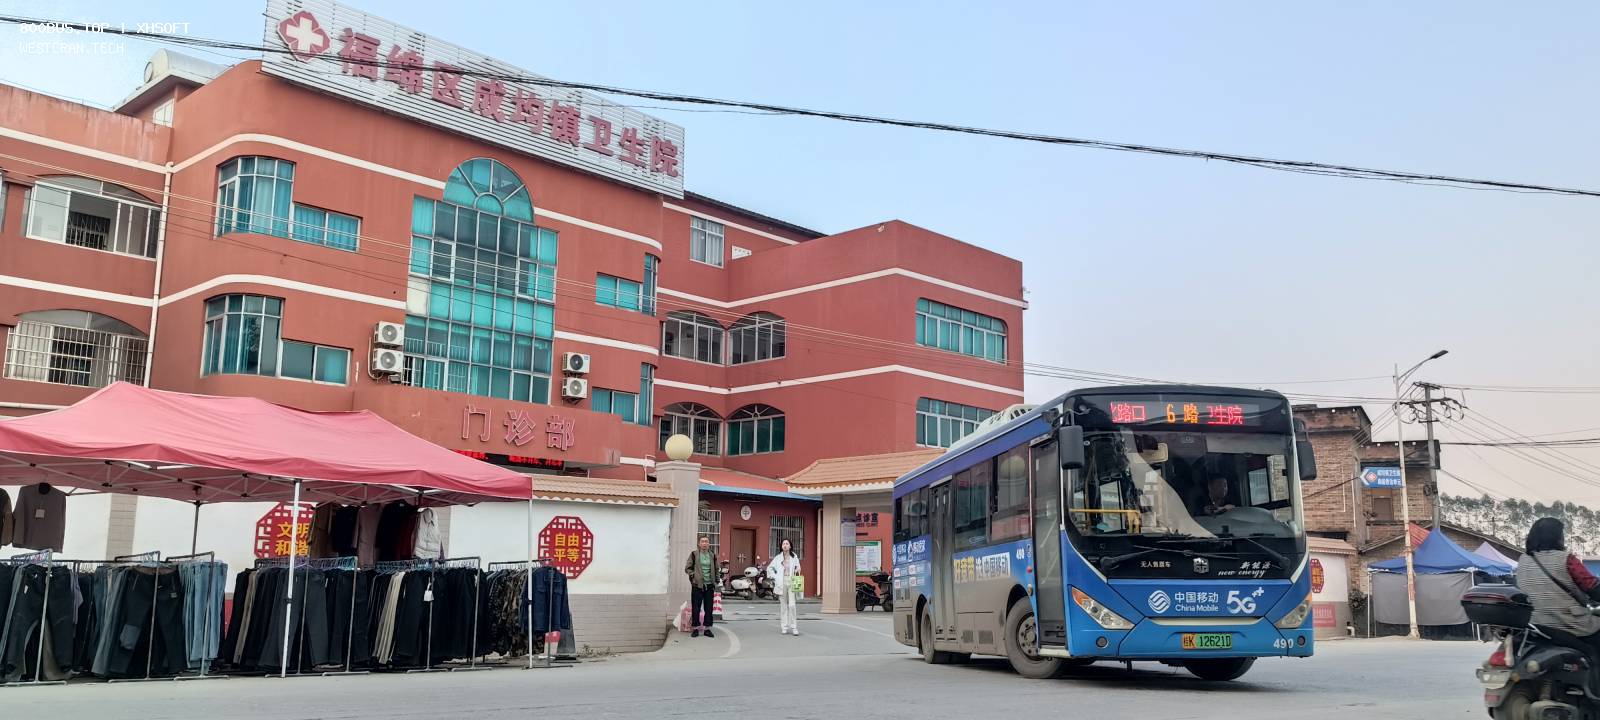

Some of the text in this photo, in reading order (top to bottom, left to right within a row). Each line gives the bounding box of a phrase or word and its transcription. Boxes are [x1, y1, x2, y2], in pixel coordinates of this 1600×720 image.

[338, 27, 679, 178] 福绵区成均镇卫生院
[1166, 403, 1176, 423] 6
[1183, 403, 1200, 423] 路
[461, 403, 576, 451] 门诊部
[277, 521, 310, 539] 文明
[555, 531, 580, 547] 自由
[274, 539, 309, 556] 和谐
[553, 547, 580, 563] 平等
[1140, 560, 1171, 568] 无人售票车
[1240, 561, 1271, 569] 新能源
[1238, 569, 1265, 578] energy
[1174, 591, 1219, 603] 中国移动
[1175, 604, 1219, 612] China Mobile
[1199, 635, 1231, 647] 12621D
[1273, 638, 1294, 649] 490
